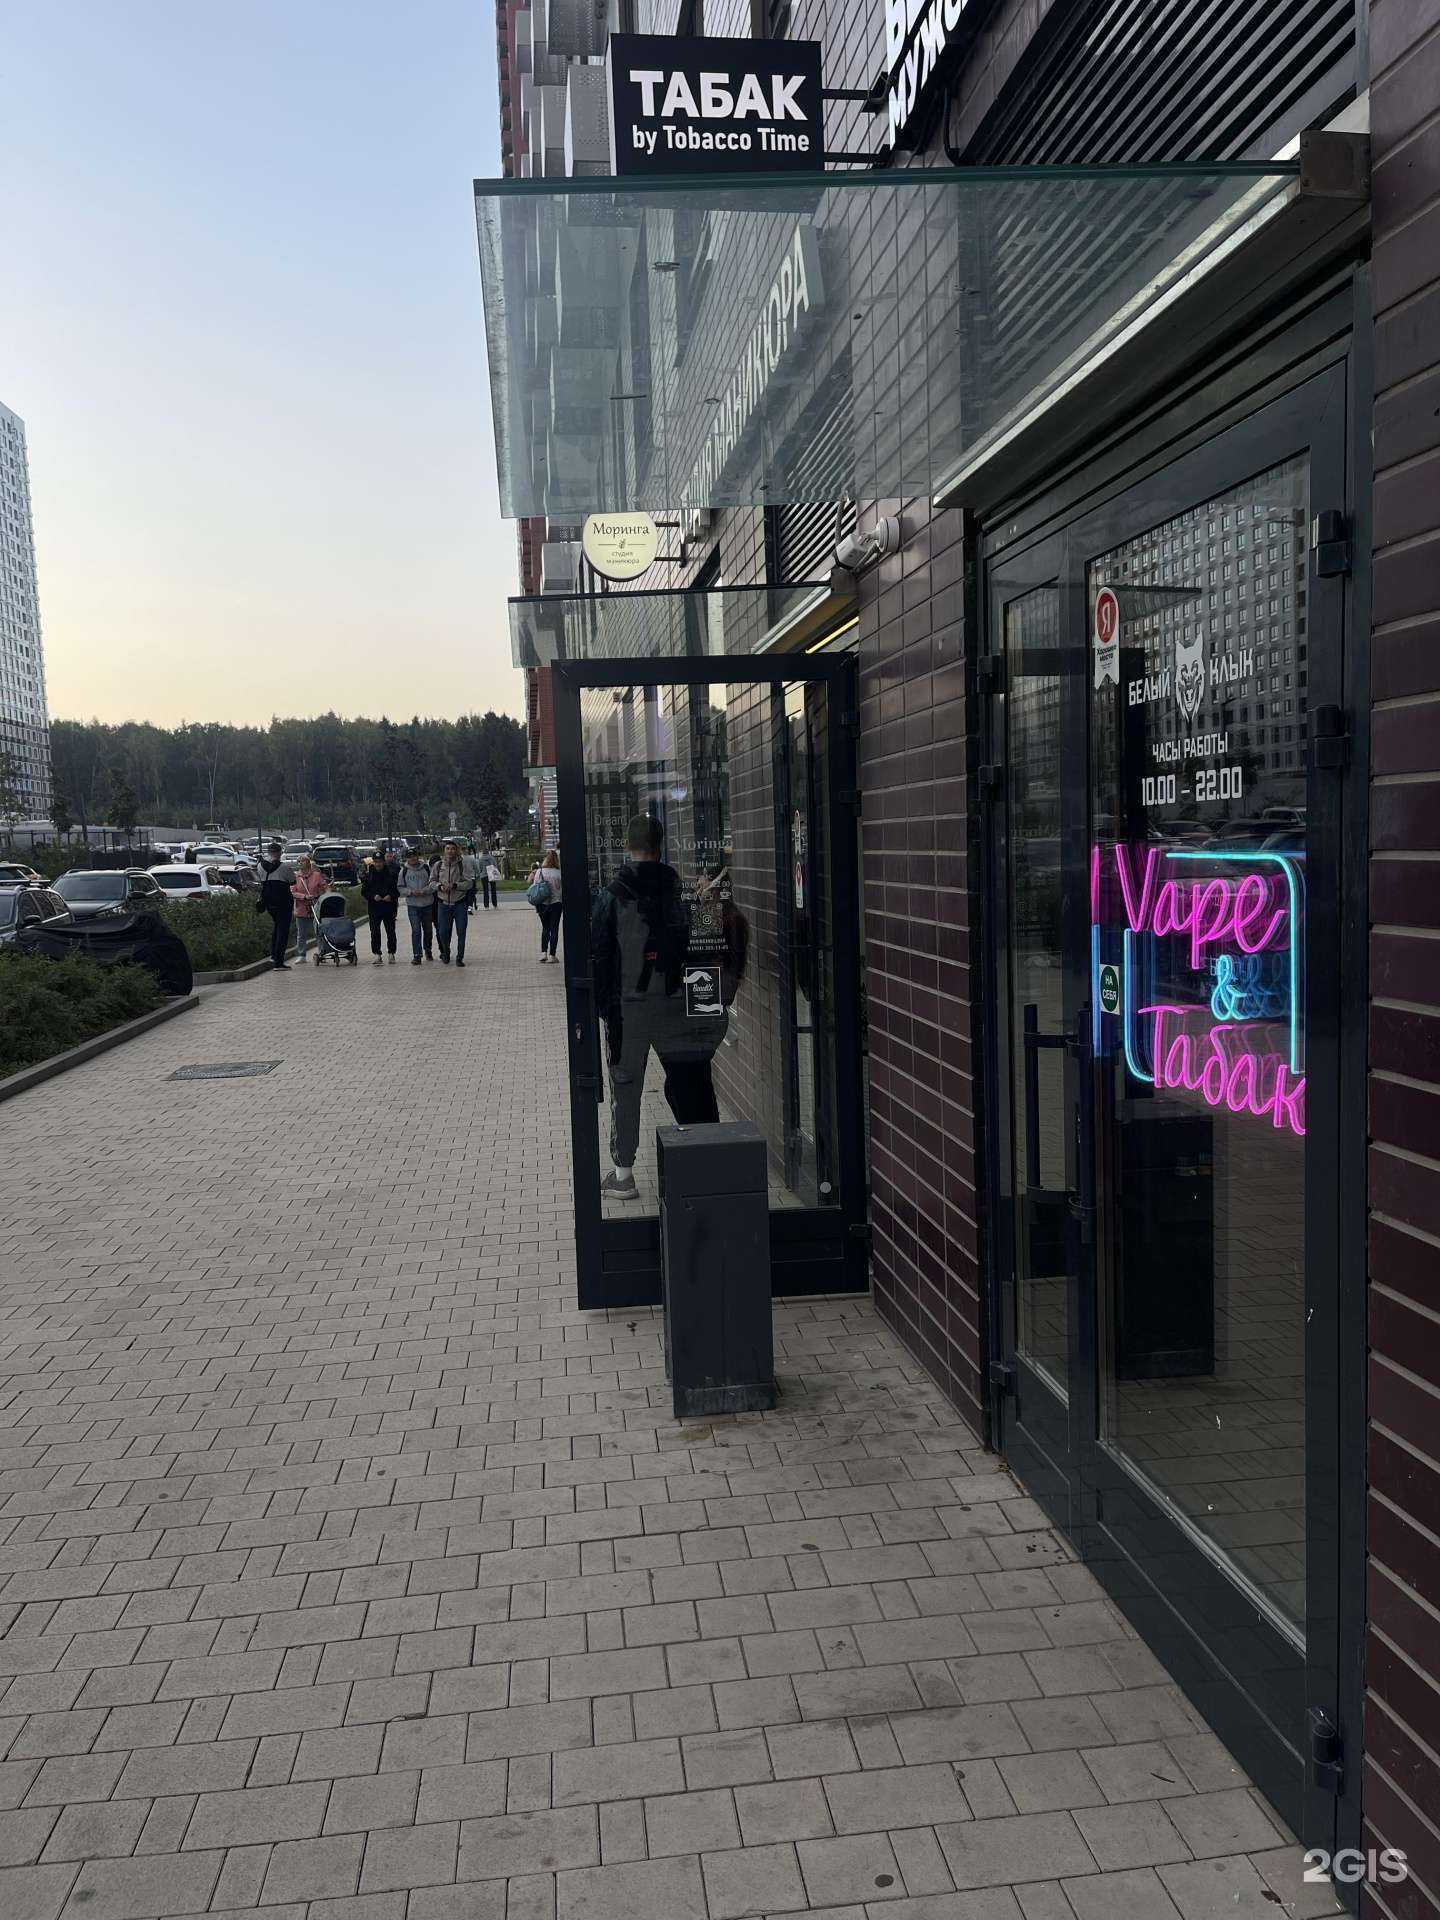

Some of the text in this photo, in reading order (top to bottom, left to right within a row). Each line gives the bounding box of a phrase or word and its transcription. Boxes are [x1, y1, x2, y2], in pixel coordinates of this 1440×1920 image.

[629, 70, 808, 121] ТАБАК
[632, 125, 810, 155] by Tobacco Time
[714, 224, 810, 481] МАНИКЮРА
[593, 521, 650, 538] Моринга
[1101, 601, 1112, 636] Я
[1128, 648, 1254, 706] БЕЛЫЙ КЛЫК
[1152, 731, 1229, 763] ЧАСЫ РАБОТЫ
[1141, 774, 1176, 807] 10.00
[1195, 765, 1243, 802] 22.00
[1115, 843, 1286, 970] Vape
[1102, 988, 1117, 1001] СЕБЯ
[1104, 975, 1114, 986] НА
[1210, 953, 1248, 1021] &
[1137, 1004, 1306, 1136] Табак
